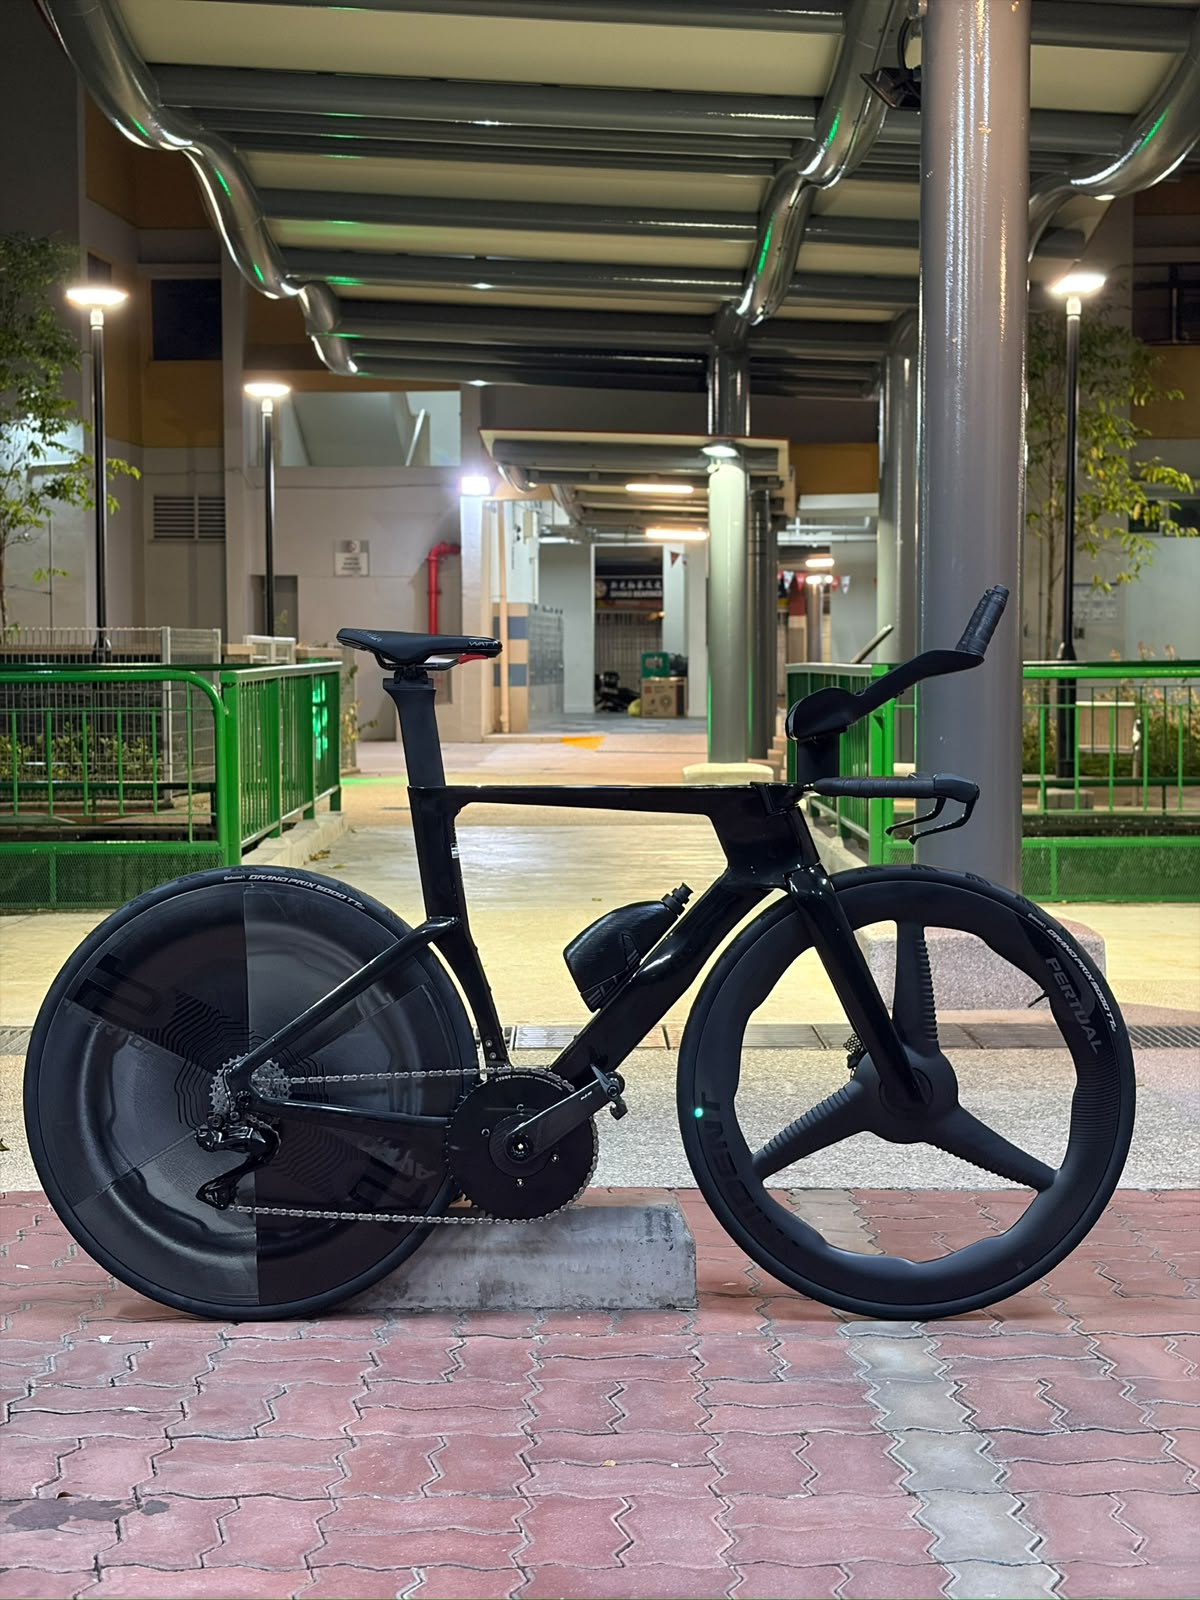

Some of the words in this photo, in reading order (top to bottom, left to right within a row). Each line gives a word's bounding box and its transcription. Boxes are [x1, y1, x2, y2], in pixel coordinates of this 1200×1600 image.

[248, 874, 289, 882] GRAND
[288, 878, 317, 889] PRIX
[316, 885, 348, 900] 5000
[1045, 957, 1103, 1056] PERTUAL
[1046, 929, 1078, 959] GRAND
[1074, 957, 1095, 982] PRIX
[1090, 980, 1110, 1010] 5000
